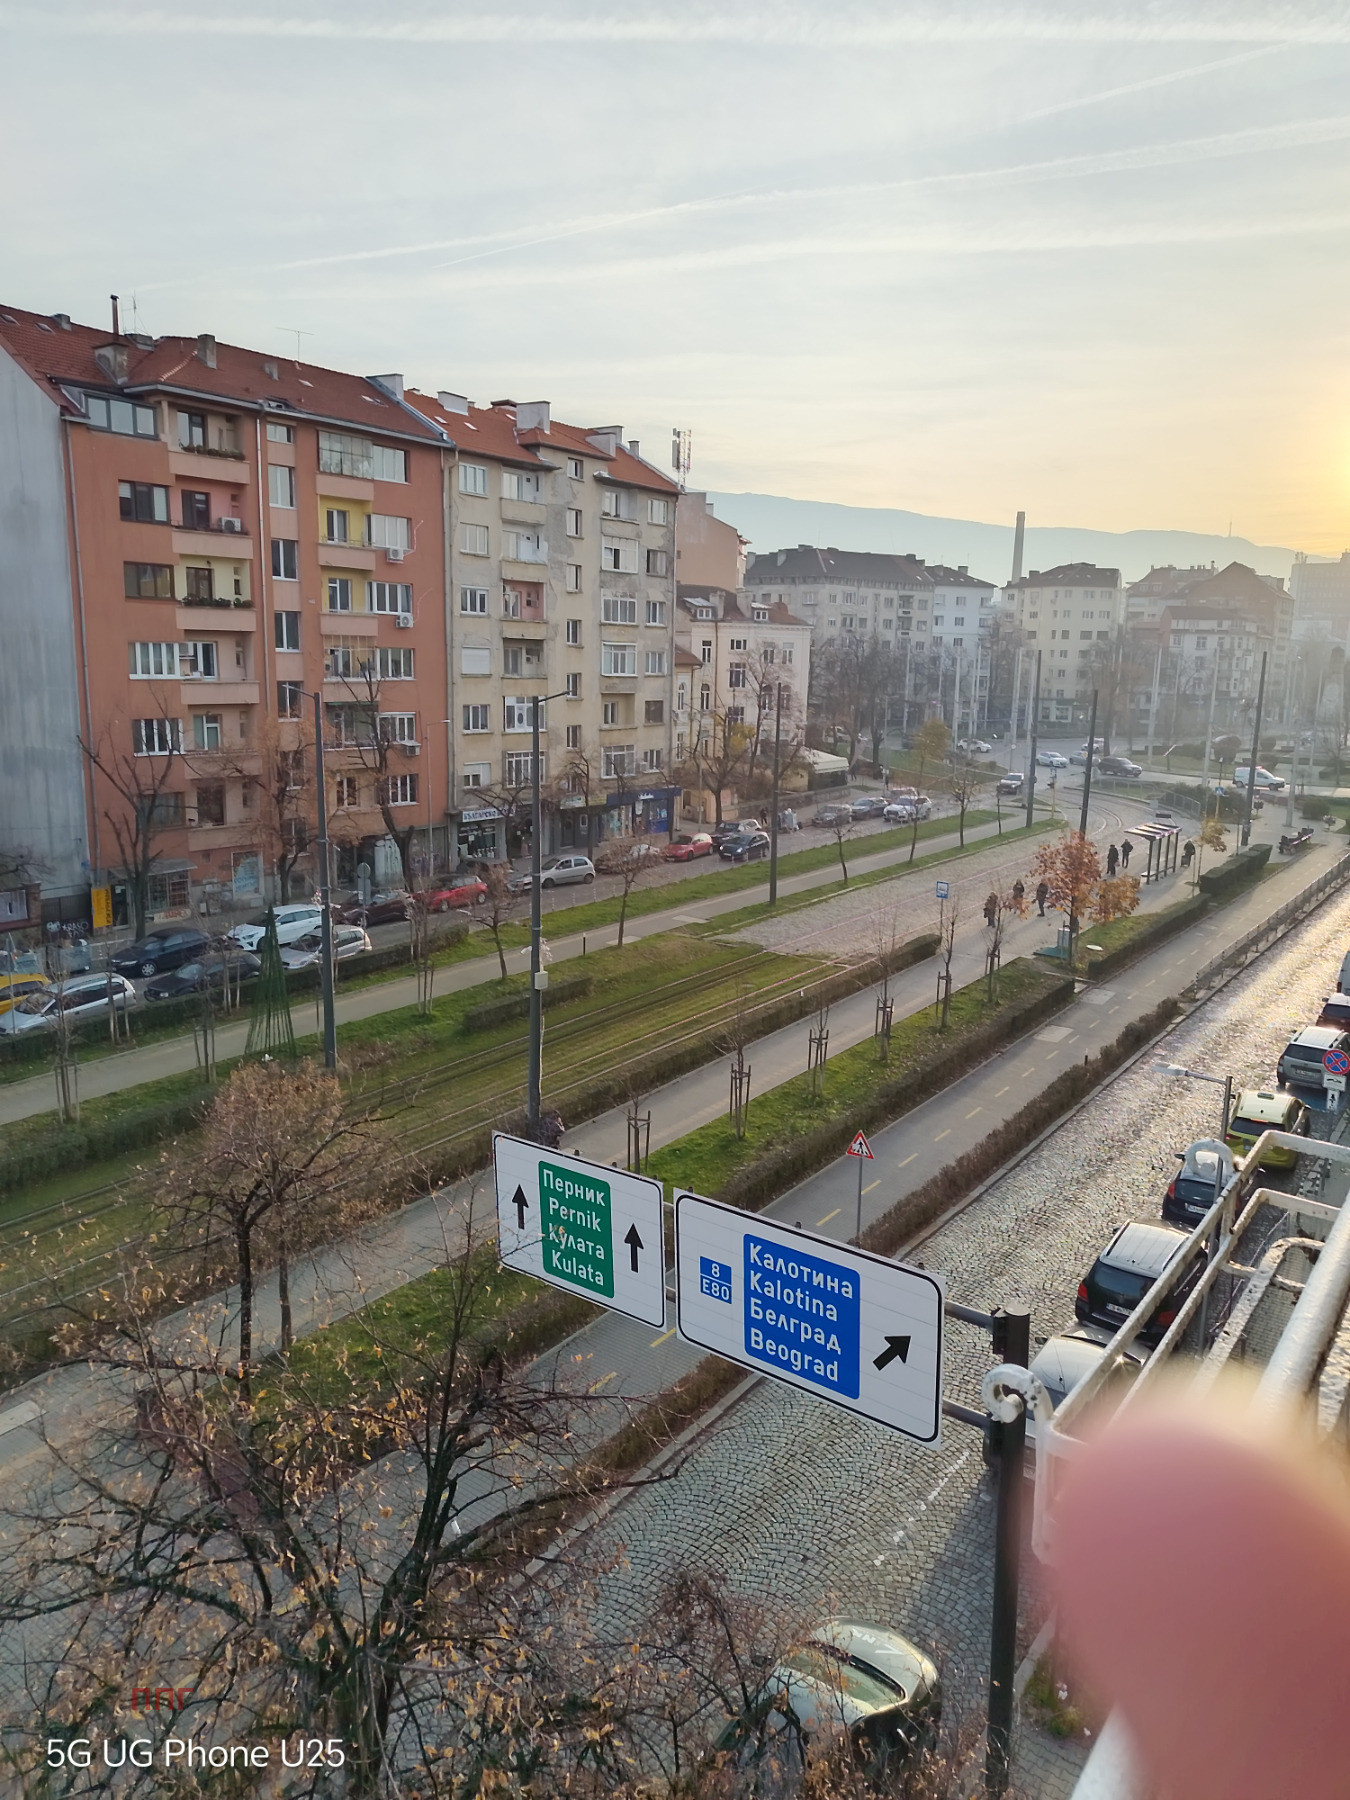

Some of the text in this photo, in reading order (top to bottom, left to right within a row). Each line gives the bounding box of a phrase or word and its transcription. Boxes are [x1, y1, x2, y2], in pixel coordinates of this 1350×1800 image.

[543, 1169, 606, 1207] Перник
[549, 1197, 602, 1232] Pernik
[548, 1222, 605, 1260] Кулата
[552, 1249, 604, 1287] Kulata
[711, 1263, 720, 1278] 8
[750, 1242, 853, 1299] Калотина
[702, 1278, 730, 1301] E80
[750, 1270, 838, 1322] Kalotina
[750, 1297, 842, 1355] Белград
[750, 1327, 838, 1382] Beograd
